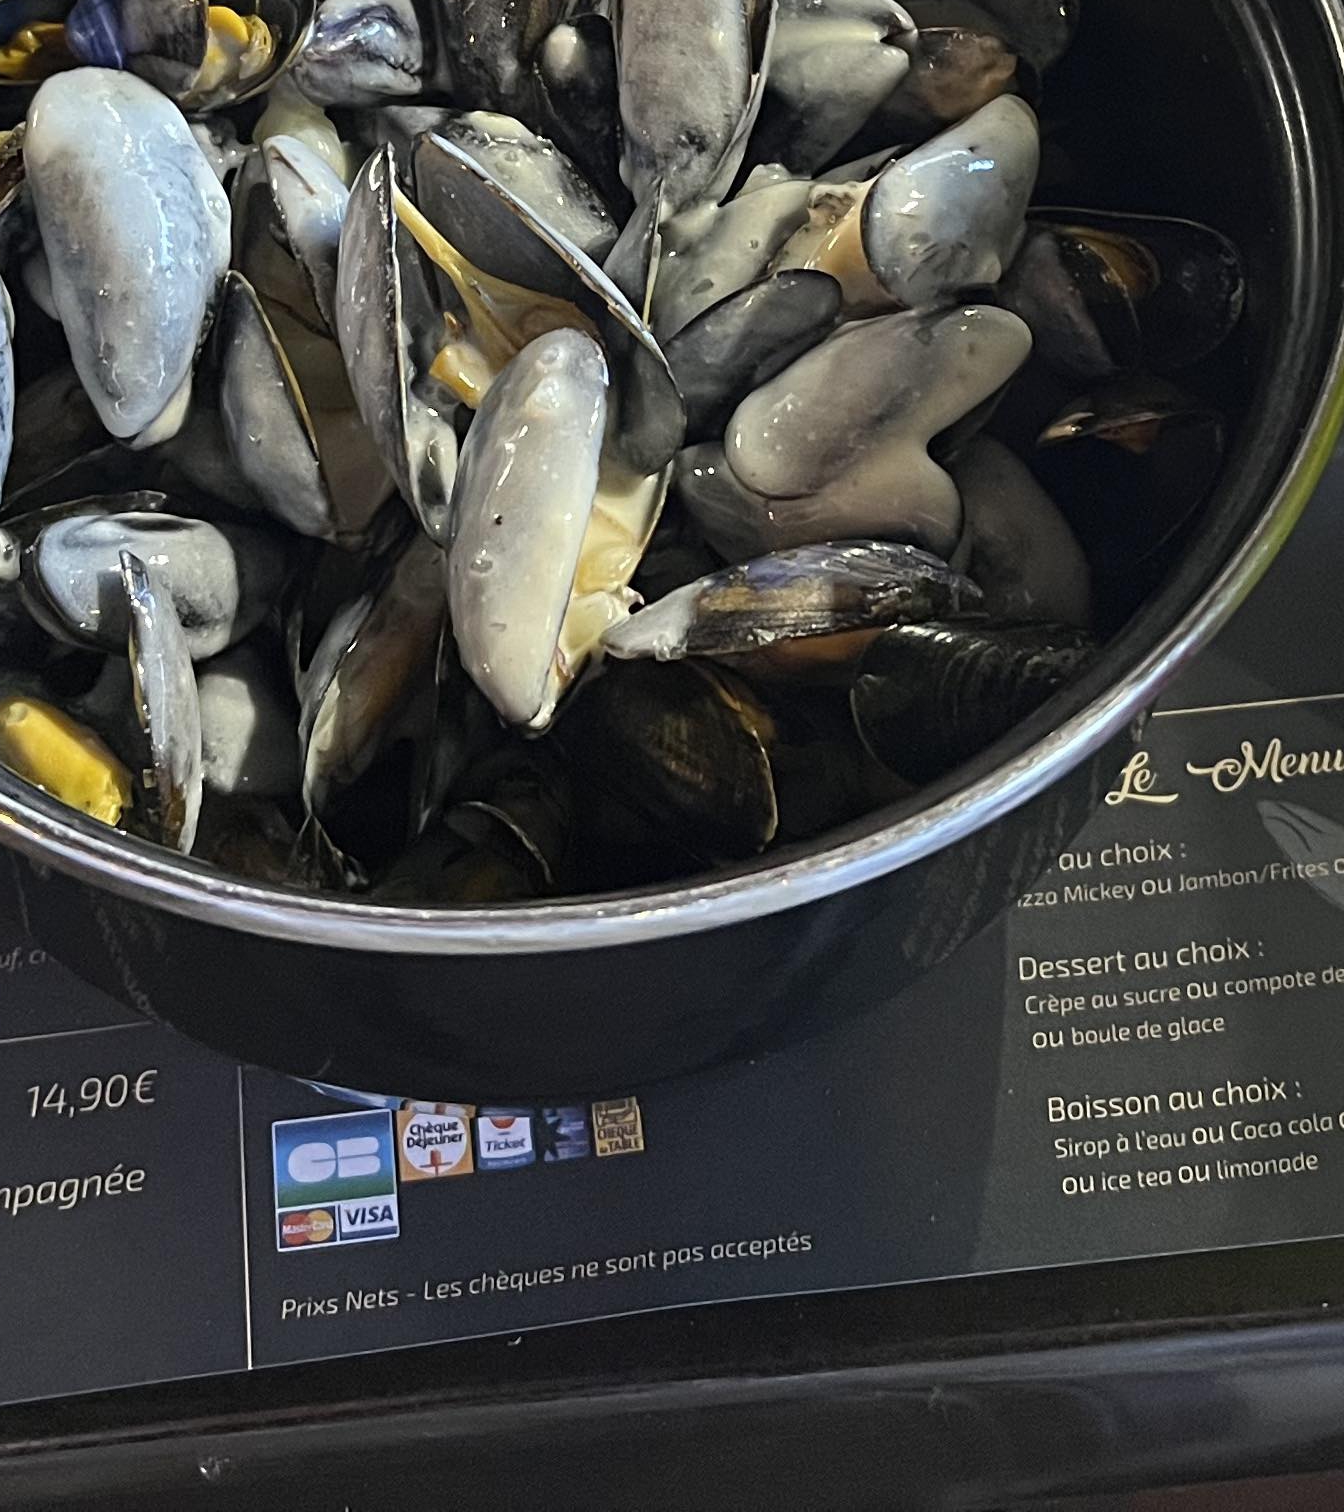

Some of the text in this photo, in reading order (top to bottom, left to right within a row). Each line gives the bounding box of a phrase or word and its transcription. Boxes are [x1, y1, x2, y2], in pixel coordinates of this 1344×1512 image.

[1104, 751, 1179, 806] Le
[1058, 851, 1092, 871] au
[1100, 839, 1173, 866] choix
[1064, 882, 1136, 904] Mickey
[1018, 951, 1126, 982] Dessert
[1134, 948, 1168, 971] au
[1176, 937, 1250, 967] choix
[1091, 993, 1118, 1010] au
[1123, 986, 1181, 1007] sucre
[1224, 970, 1317, 996] compote
[1071, 1023, 1130, 1046] boule
[1136, 1020, 1162, 1040] de
[1168, 1015, 1225, 1042] glace
[27, 1070, 158, 1118] 14,90€
[1048, 1094, 1160, 1123] Boisson
[1168, 1090, 1204, 1111] au
[1212, 1076, 1287, 1108] choix
[409, 1120, 459, 1138] Chèque
[485, 1137, 526, 1152] Ticket
[1054, 1136, 1111, 1160] Sirop
[1116, 1133, 1130, 1153] à
[1135, 1129, 1186, 1151] l'eau
[1231, 1120, 1282, 1141] Coca
[1288, 1113, 1333, 1135] cola
[1101, 1170, 1132, 1192] ice
[1137, 1166, 1172, 1187] tea
[1217, 1151, 1319, 1180] limonade
[344, 1204, 394, 1226] VISA
[281, 1291, 338, 1320] Prixs
[346, 1287, 399, 1312] Nets
[423, 1280, 462, 1302] Les
[469, 1264, 565, 1292] chèques
[571, 1260, 599, 1280] ne
[606, 1249, 656, 1275] sont
[663, 1245, 704, 1270] pas
[711, 1231, 813, 1259] acceptés
